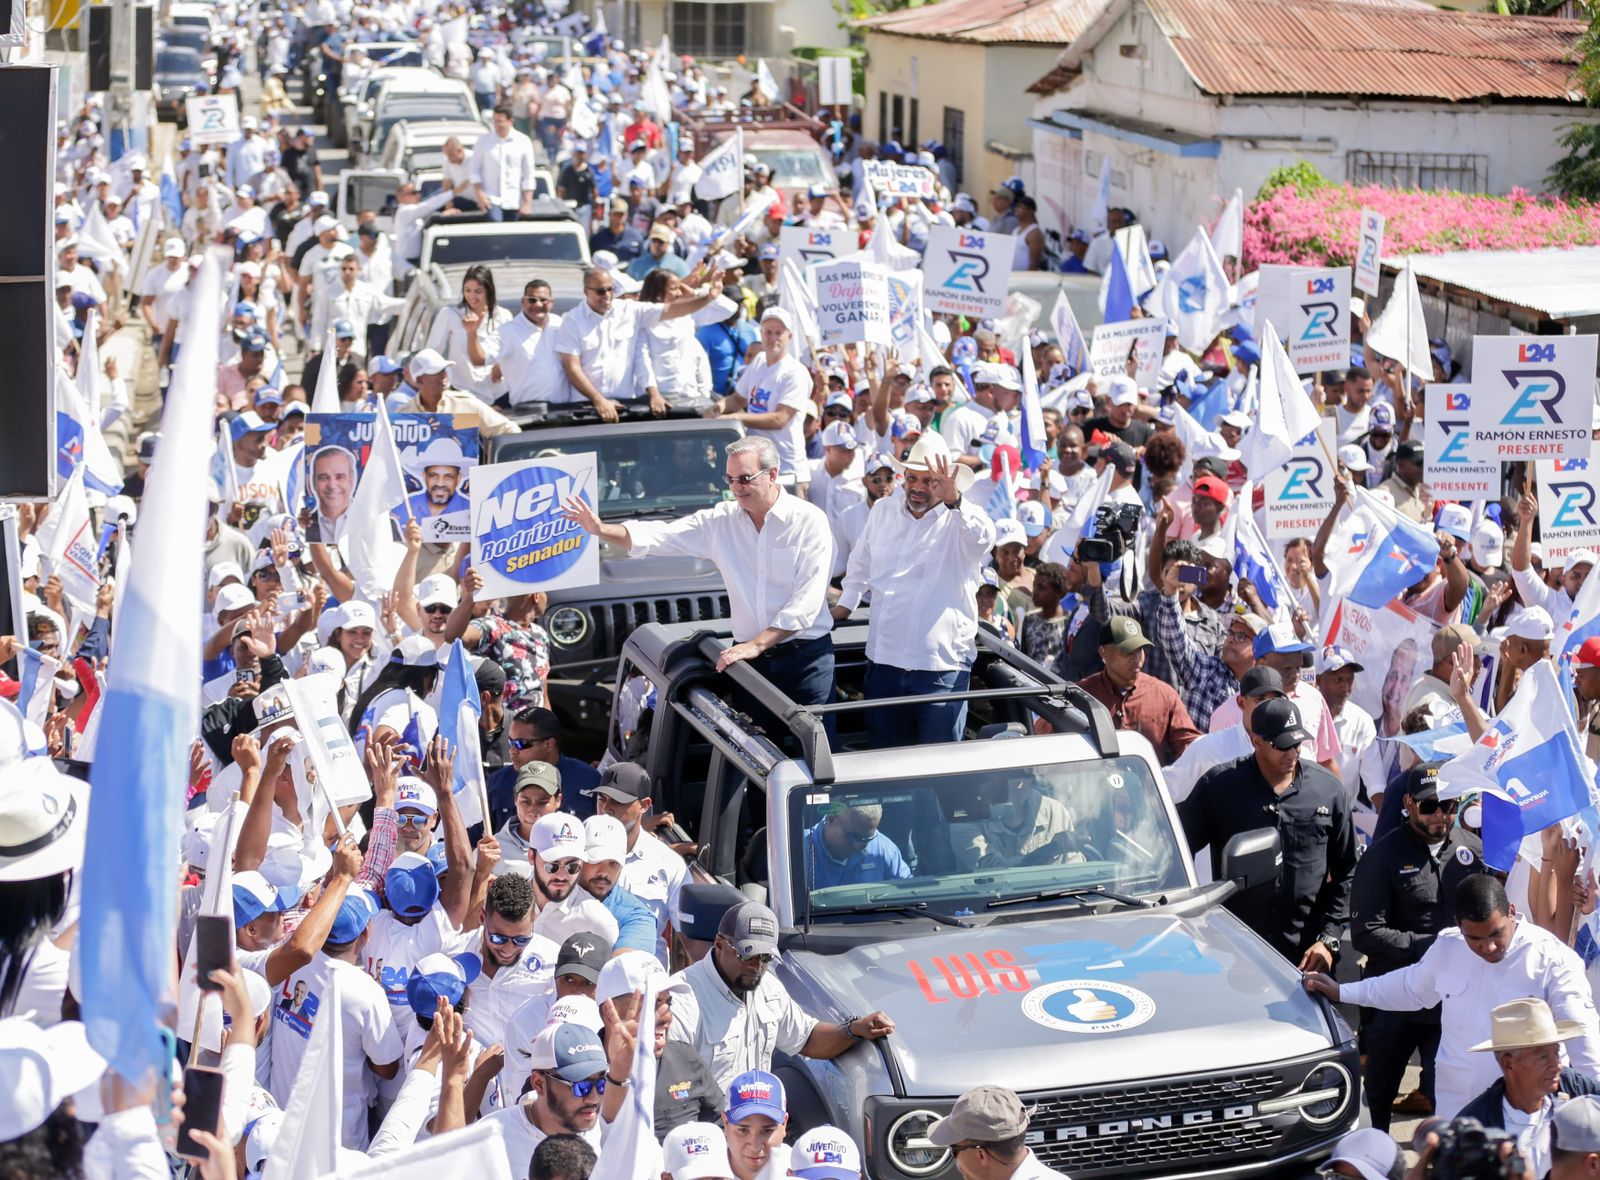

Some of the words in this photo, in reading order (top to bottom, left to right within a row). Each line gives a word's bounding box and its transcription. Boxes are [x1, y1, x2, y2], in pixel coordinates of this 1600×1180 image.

[868, 164, 927, 181] Mujeres
[808, 233, 832, 246] L24
[959, 234, 985, 250] L24
[818, 272, 838, 283] LAS
[1306, 277, 1335, 296] L24
[924, 288, 959, 300] RAMÓN
[960, 294, 1002, 307] ERNESTO
[938, 300, 985, 314] PRESENTE
[1113, 325, 1150, 337] MUJERES
[1151, 324, 1163, 333] DE
[1292, 342, 1317, 351] RAMÓN
[1318, 338, 1347, 348] ERNESTO
[1296, 352, 1341, 365] PRESENTE
[1518, 343, 1557, 363] L24
[1100, 361, 1144, 377] GANR
[1446, 393, 1471, 411] L2
[1475, 428, 1525, 441] RAMÓN
[1529, 429, 1587, 441] ERNESTO
[1497, 443, 1564, 455] PRESENTE
[1427, 465, 1459, 474] RAMÓN
[1460, 466, 1497, 474] ERNESTO
[1433, 482, 1489, 492] PRESENTE
[1269, 503, 1299, 512] RAMÓN
[1300, 501, 1336, 511] ERNESTO
[1275, 518, 1328, 530] PRESENT
[907, 949, 1032, 1005] LUIS
[1025, 1104, 1254, 1145] BRONCO
[687, 1144, 709, 1154] L24
[814, 1151, 843, 1164] L24
